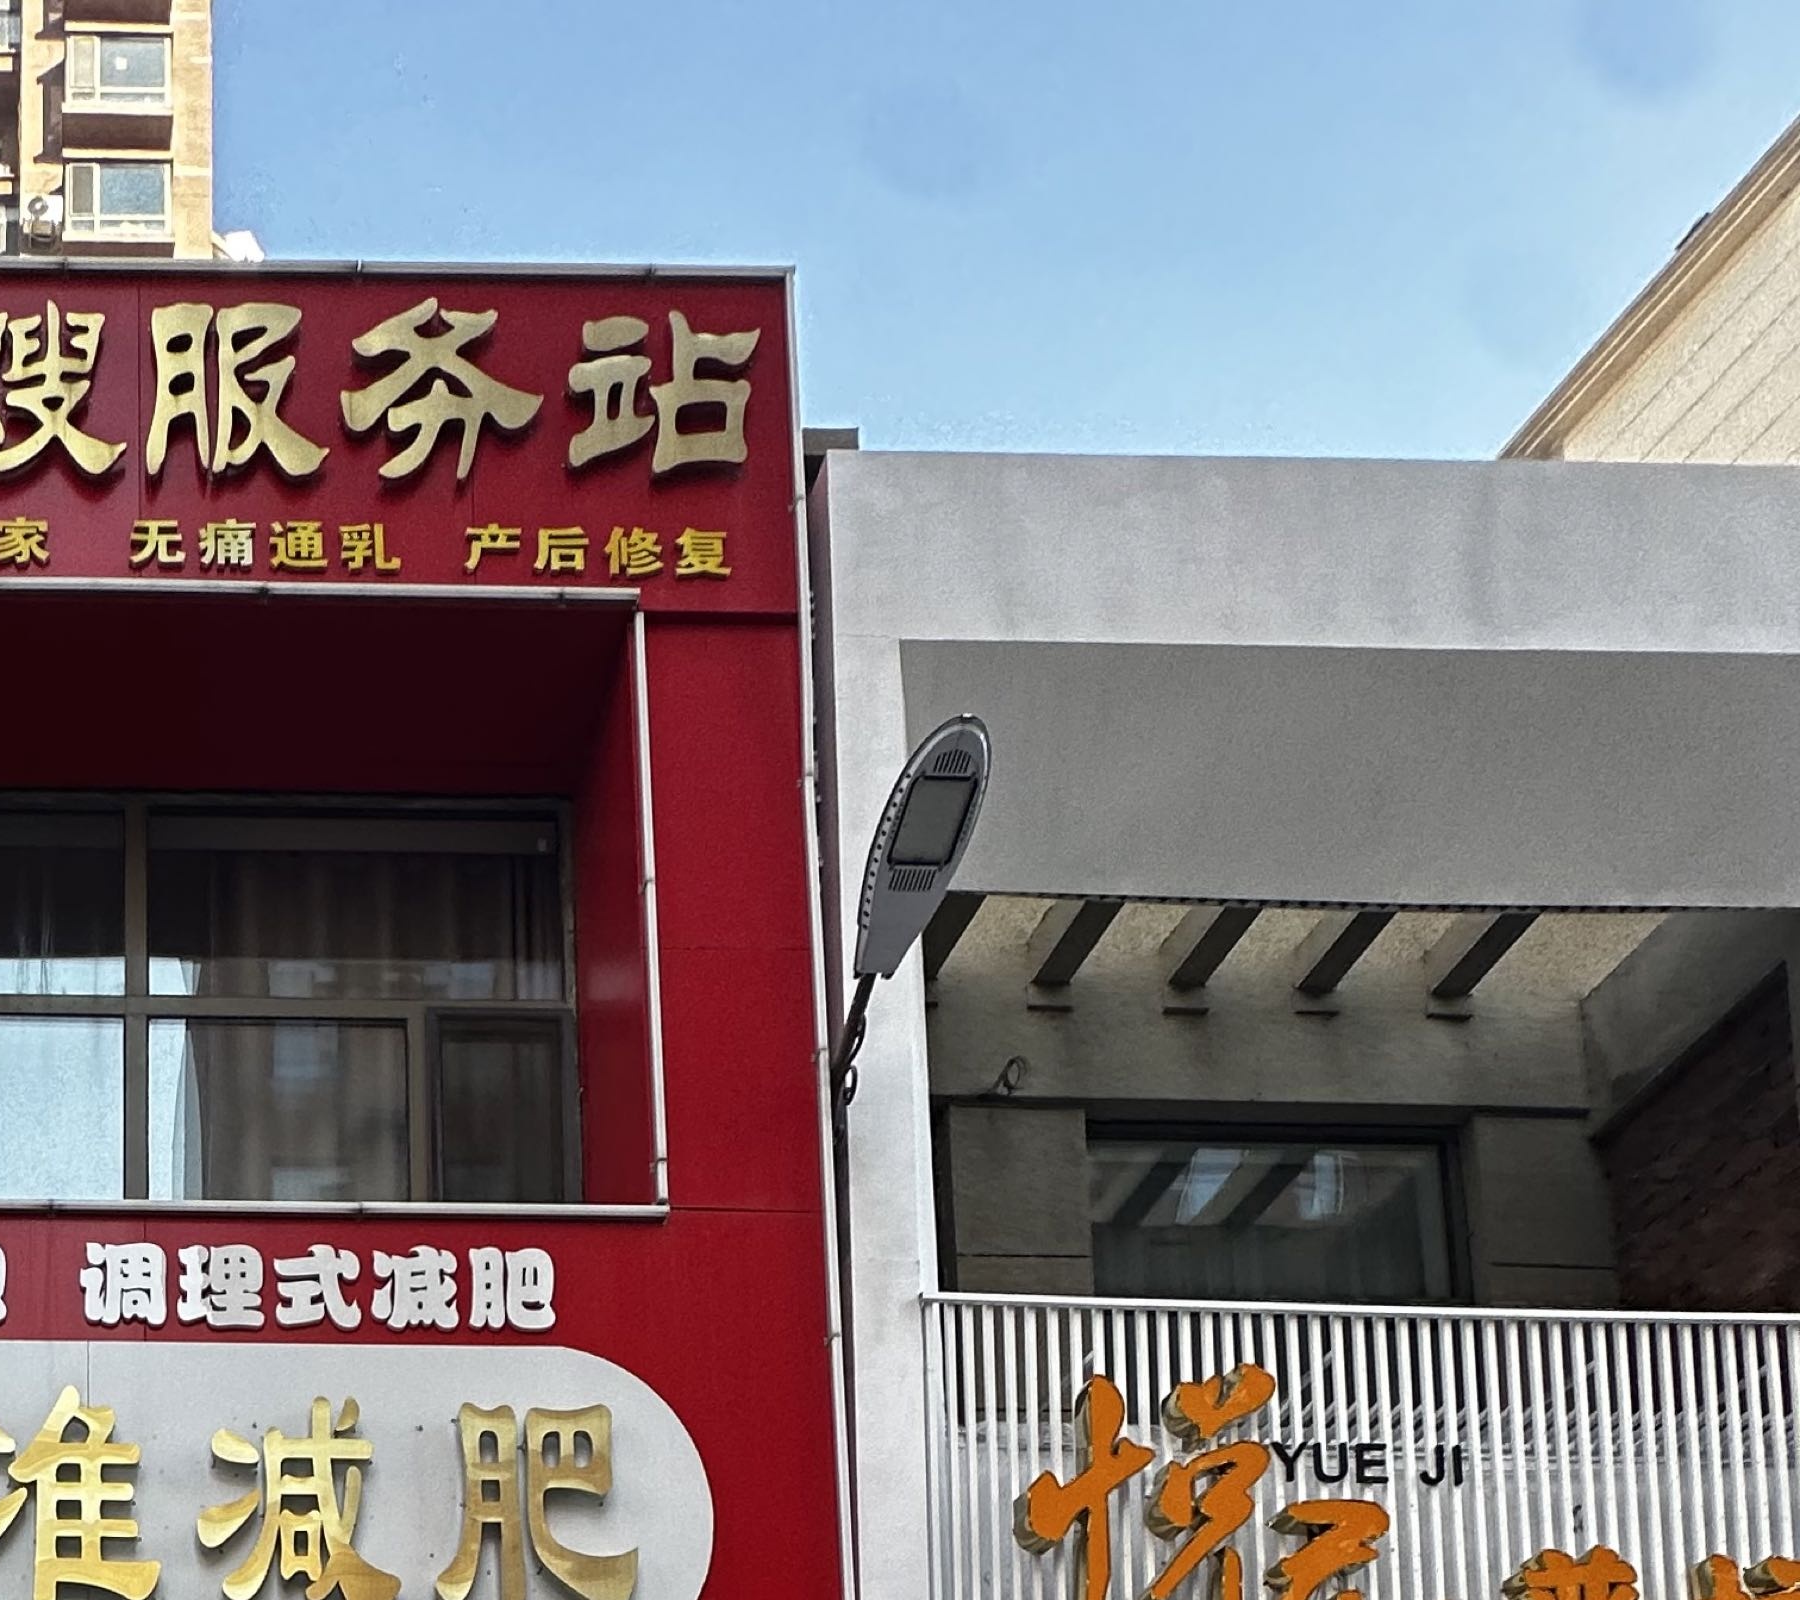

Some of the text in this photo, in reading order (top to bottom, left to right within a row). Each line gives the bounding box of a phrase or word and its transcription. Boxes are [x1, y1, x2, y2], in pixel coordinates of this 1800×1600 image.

[130, 519, 402, 571] 无痛通乳
[464, 523, 733, 577] 产后修复
[80, 1241, 558, 1332] 调理式减肥
[1269, 1442, 1465, 1487] YUE JI
